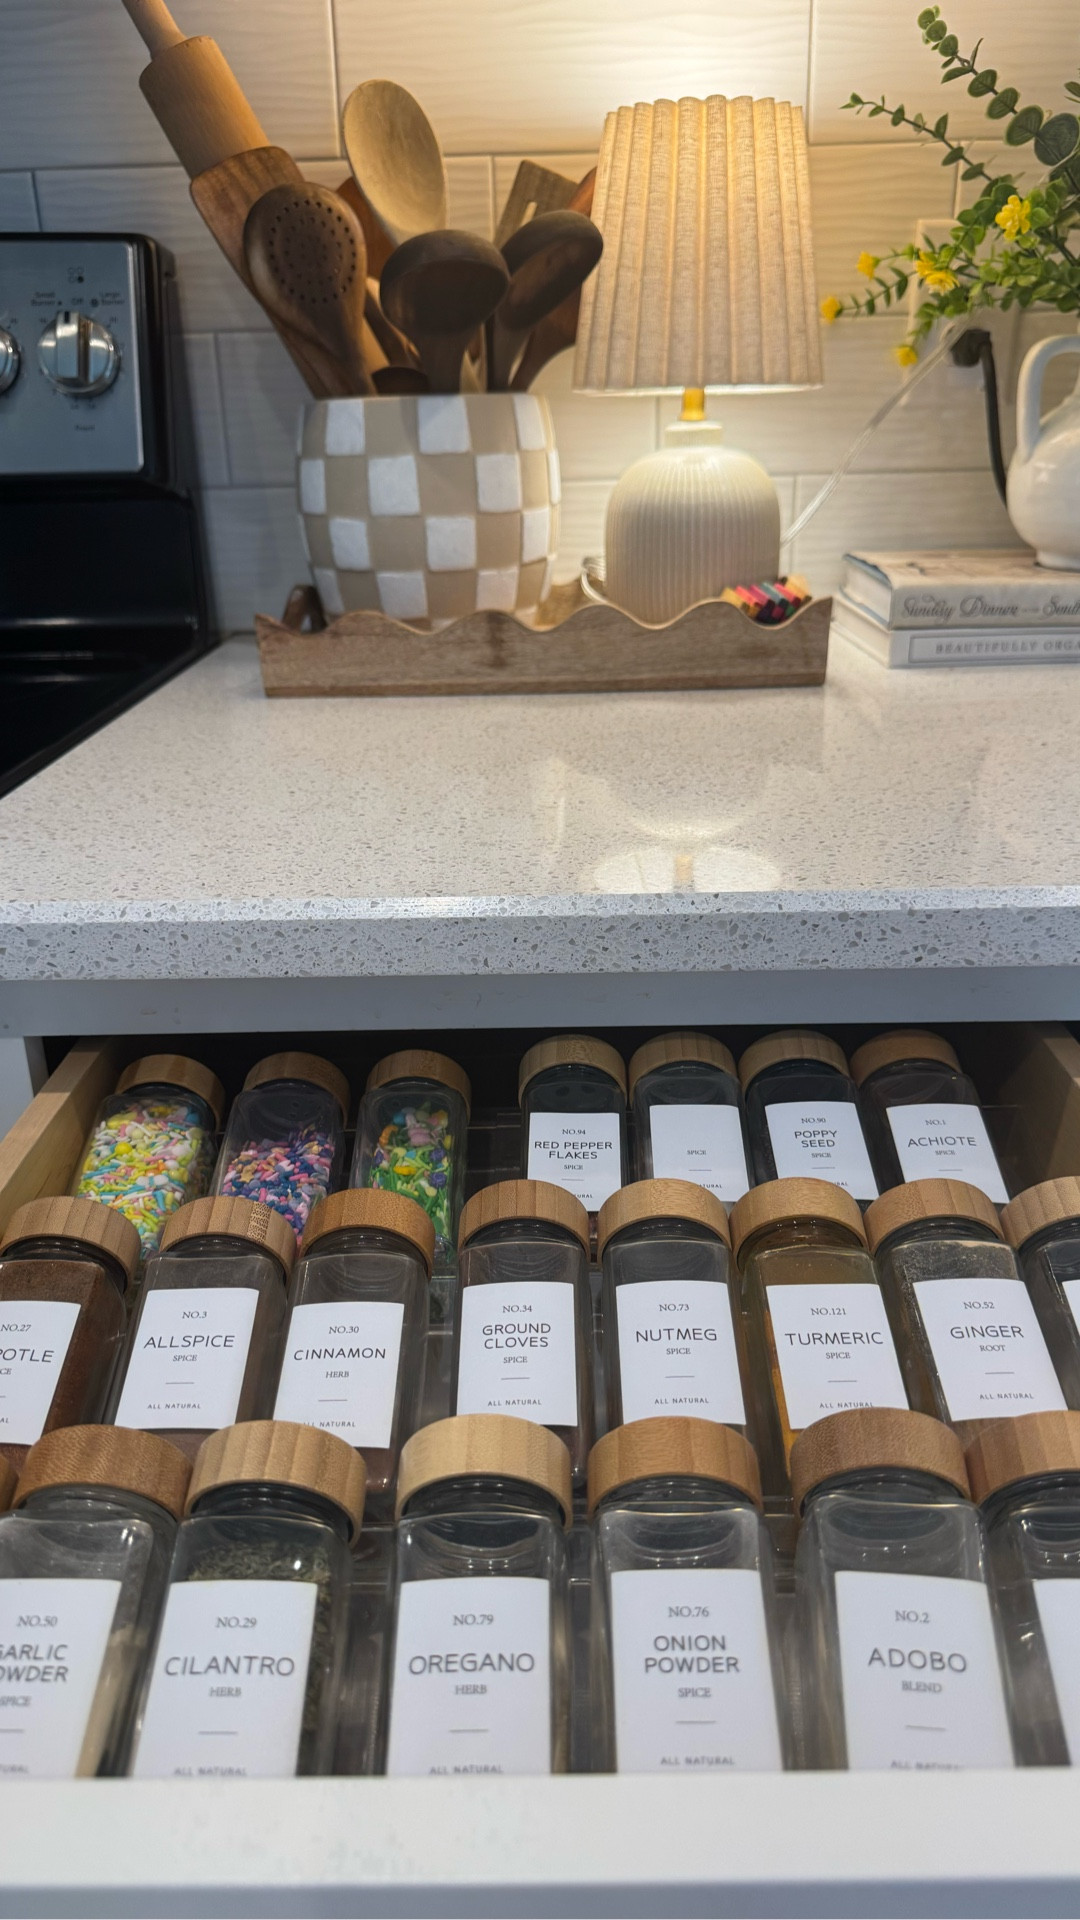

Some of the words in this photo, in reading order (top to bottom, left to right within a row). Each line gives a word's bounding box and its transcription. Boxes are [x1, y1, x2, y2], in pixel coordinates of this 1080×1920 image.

[903, 594, 954, 624] Sunday
[959, 595, 1018, 618] Dinner
[935, 641, 1038, 655] BEAUTIFULLY
[794, 1130, 837, 1139] POPPY
[535, 1141, 559, 1149] RED
[801, 1140, 835, 1148] SEED
[908, 1137, 976, 1147] ACHIOTE
[549, 1151, 597, 1159] FLAKES
[182, 1311, 207, 1319] NO.3
[503, 1305, 532, 1313] NO.34
[329, 1326, 359, 1334] NO.30
[482, 1323, 552, 1336] GROUND
[636, 1328, 717, 1342] NUTMEG
[950, 1326, 1024, 1339] GINGER
[144, 1335, 235, 1348] ALLSPICE
[483, 1336, 549, 1350] CLOVES
[785, 1332, 883, 1345] TURMERIC
[294, 1348, 385, 1360] CINNAMON
[318, 1421, 355, 1429] NATURAL
[668, 1606, 709, 1617] NO.76
[895, 1610, 930, 1624] NO.2
[16, 1615, 58, 1627] NO.50
[216, 1617, 257, 1628] NO.29
[453, 1614, 494, 1626] NO.79
[654, 1635, 726, 1651] ONION
[164, 1656, 295, 1676] CILANTRO
[409, 1653, 535, 1675] OREGANO
[645, 1657, 739, 1673] POWDER
[868, 1648, 967, 1673] ADOBO
[209, 1687, 241, 1697] HERB
[455, 1684, 487, 1695] HERB
[678, 1687, 711, 1698] SPICE
[902, 1681, 942, 1694] BLEND
[660, 1757, 681, 1766] ALL
[685, 1756, 736, 1766] NATURAL
[172, 1765, 194, 1776] ALL
